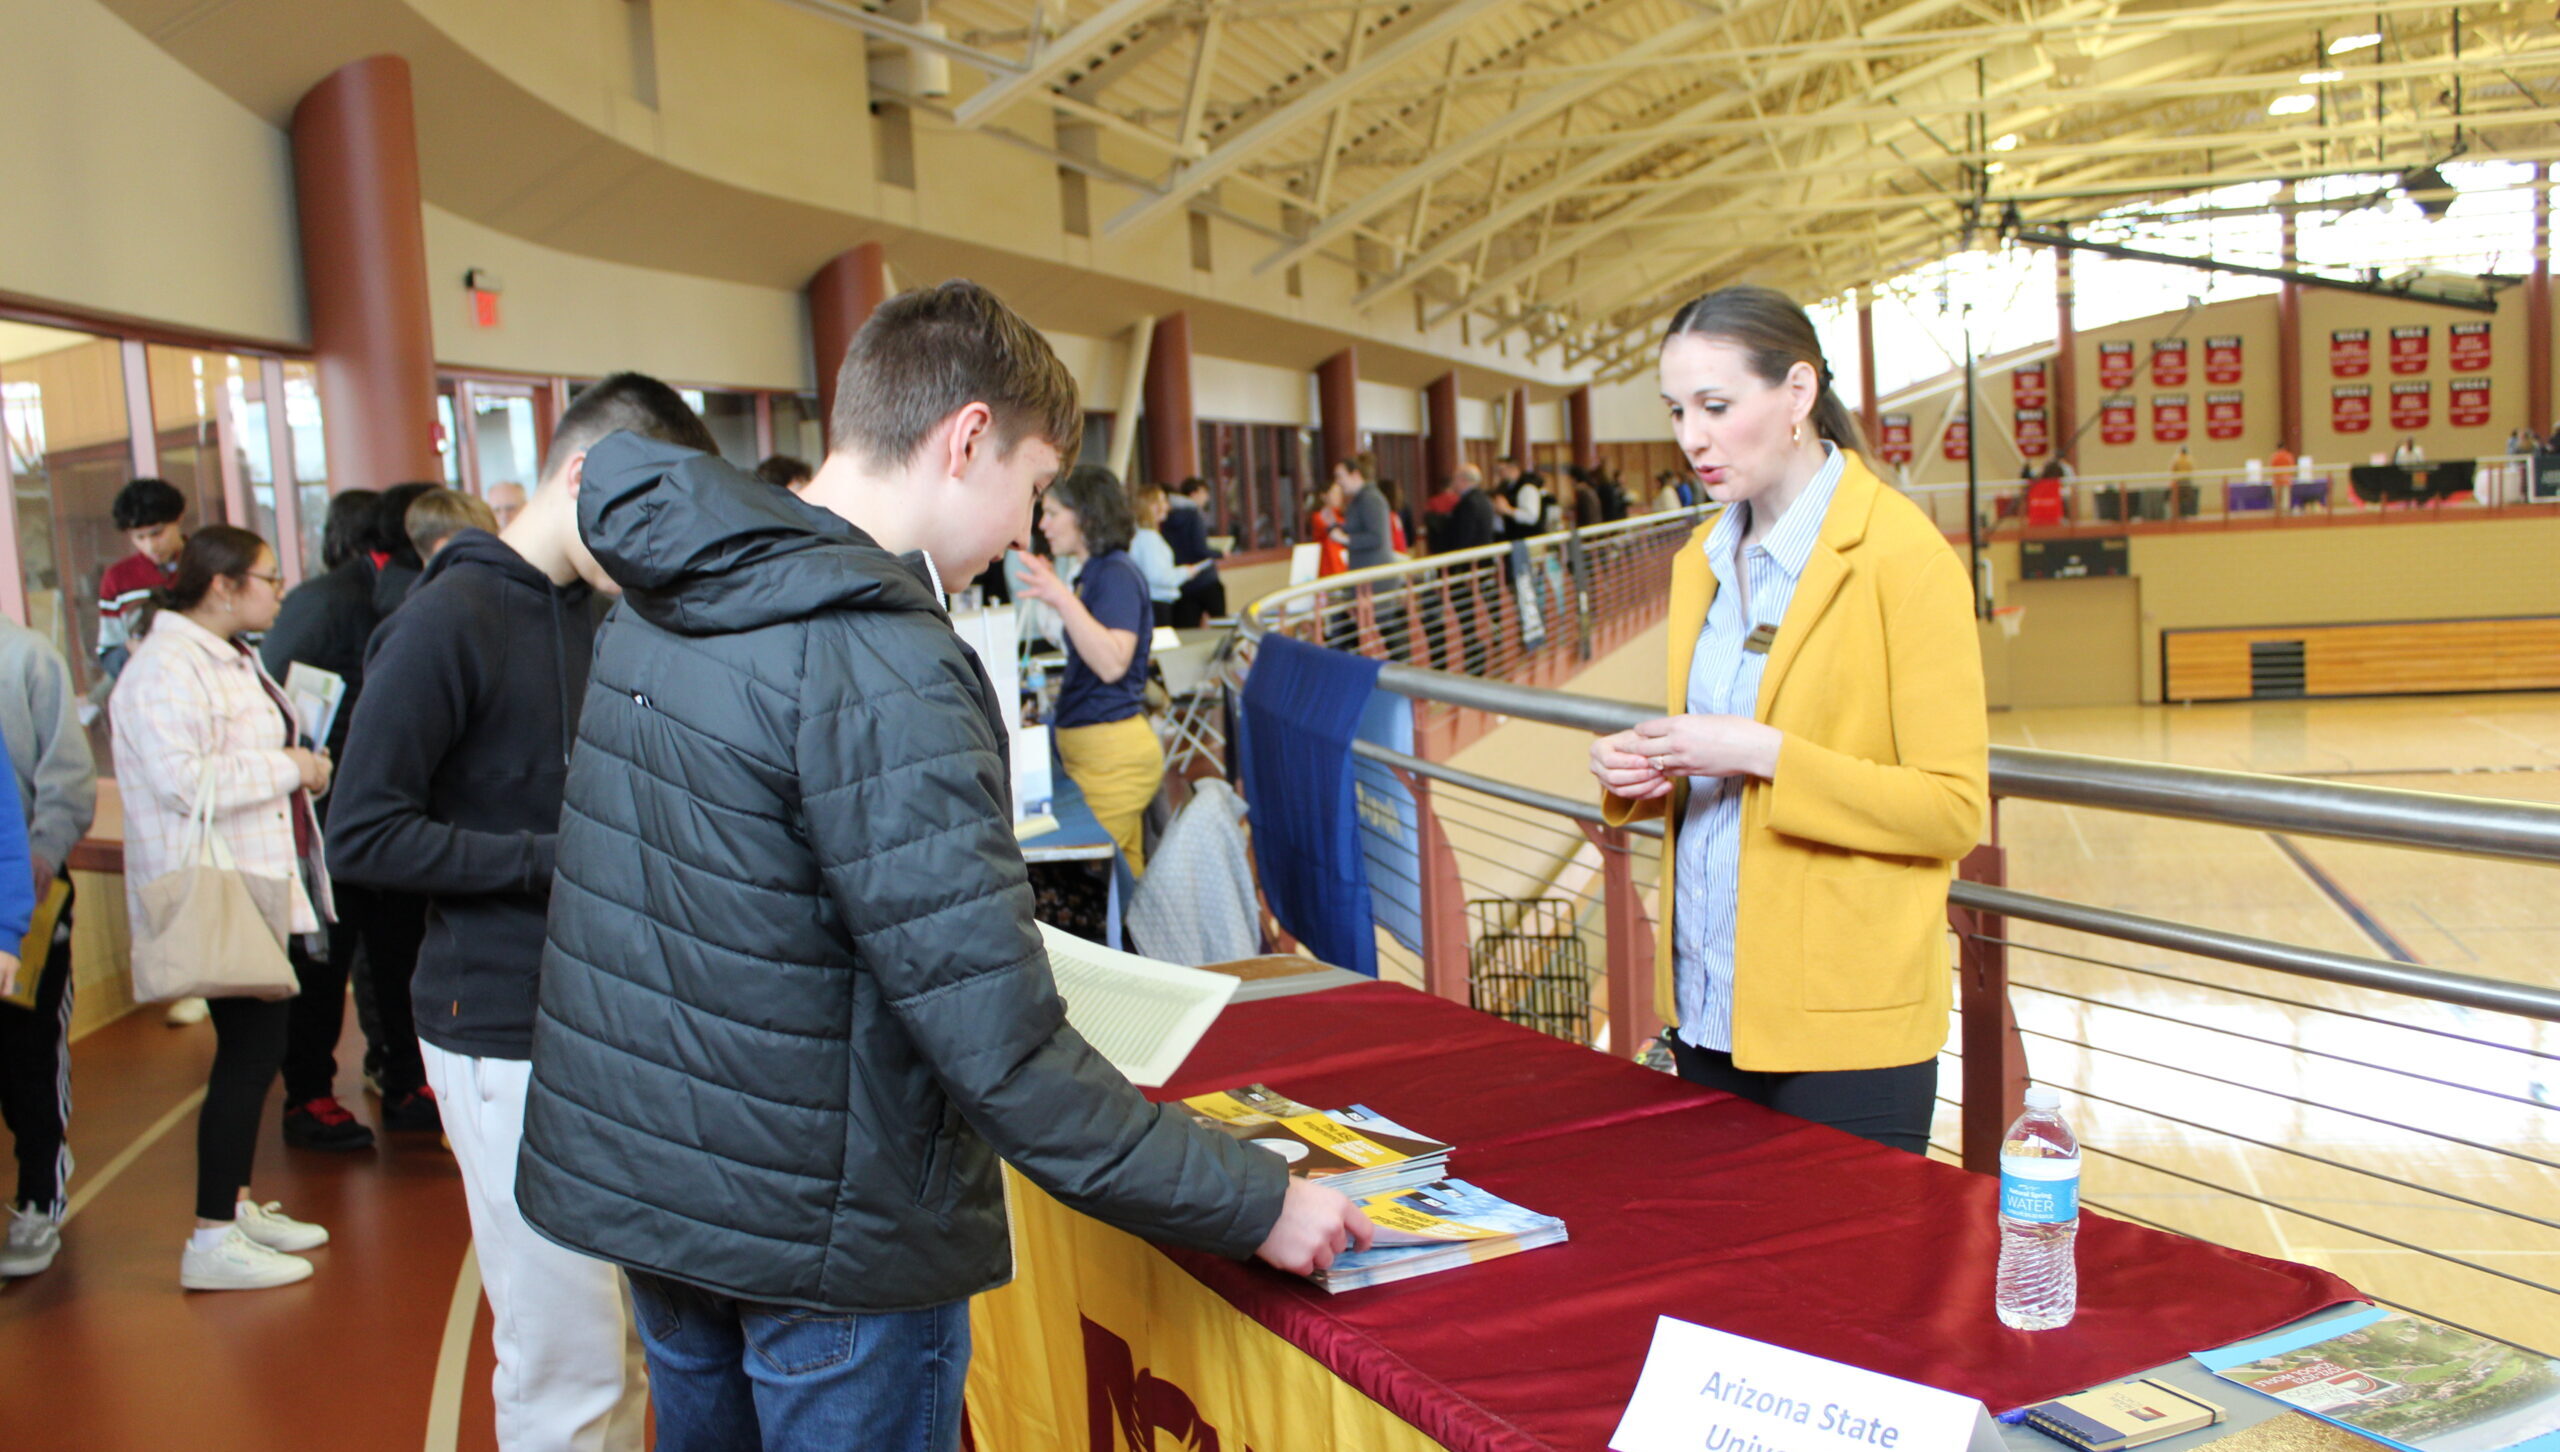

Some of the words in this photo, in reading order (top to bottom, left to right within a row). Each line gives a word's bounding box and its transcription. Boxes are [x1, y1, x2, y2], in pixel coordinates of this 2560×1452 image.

[2007, 1195, 2055, 1212] WATER
[1700, 1371, 1811, 1425] Arizona
[1818, 1403, 1899, 1449] State
